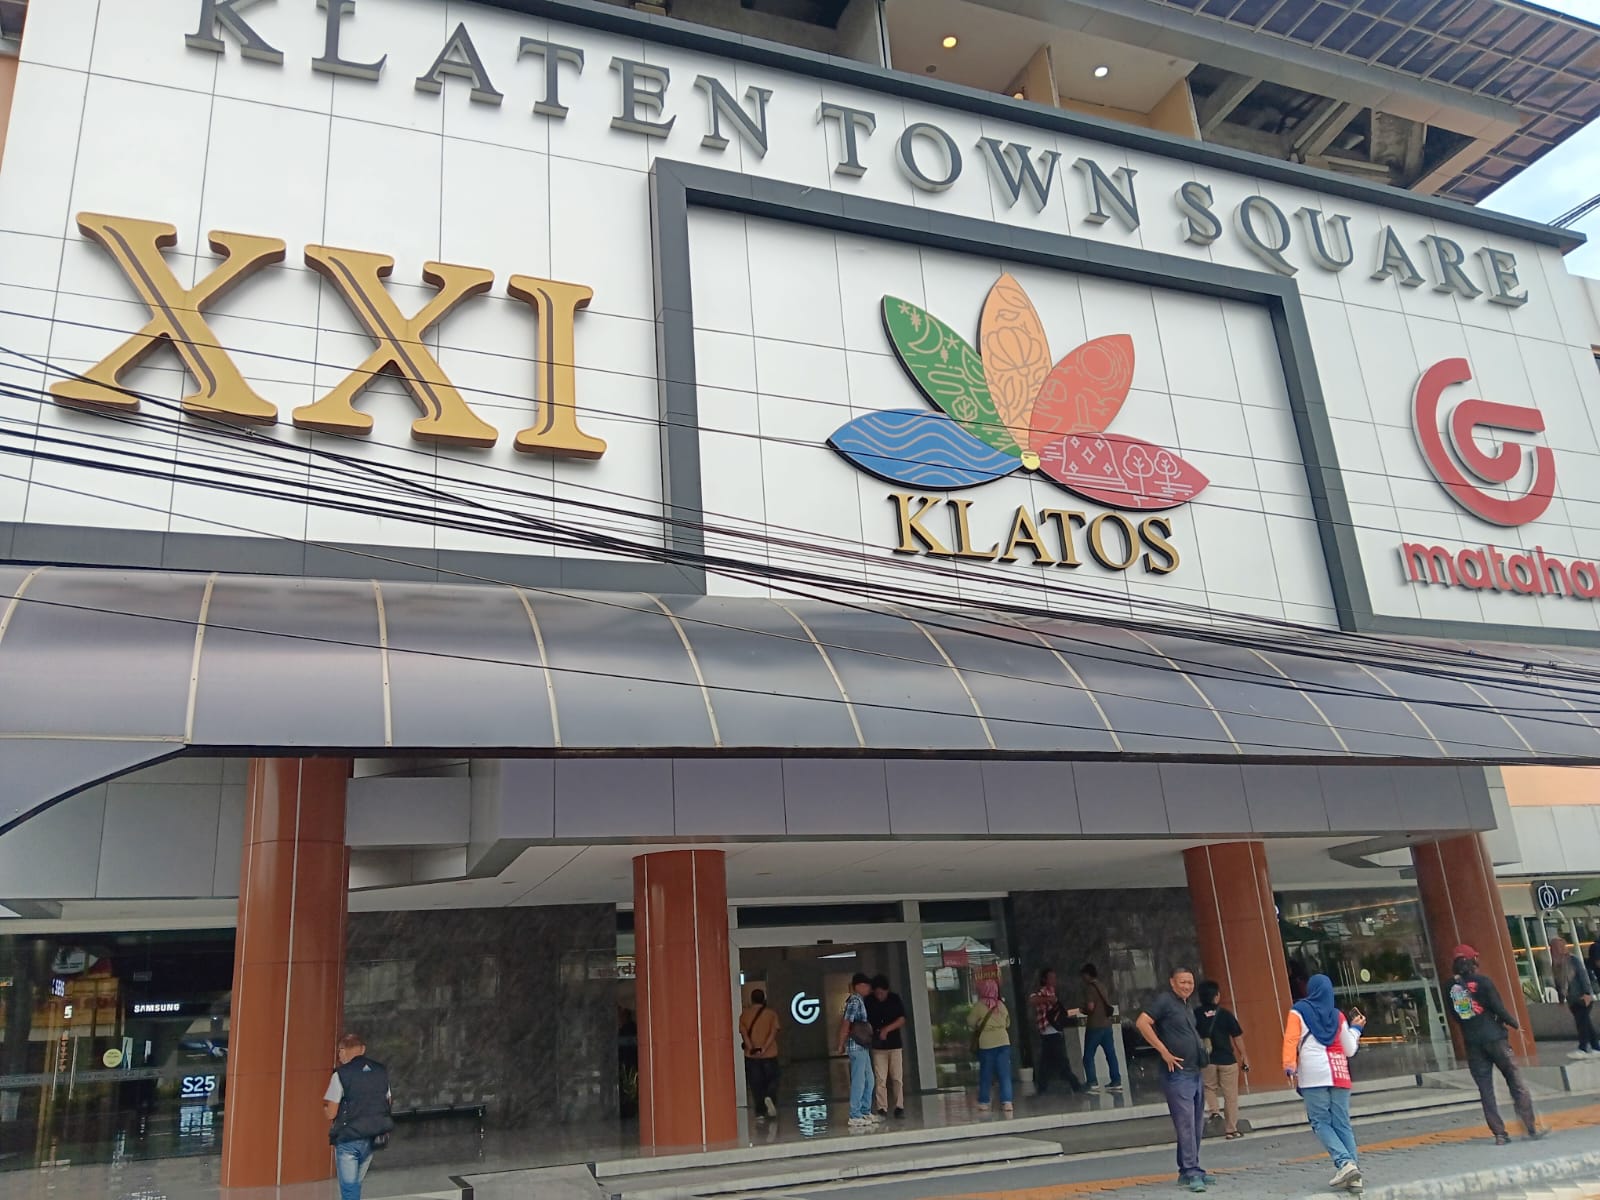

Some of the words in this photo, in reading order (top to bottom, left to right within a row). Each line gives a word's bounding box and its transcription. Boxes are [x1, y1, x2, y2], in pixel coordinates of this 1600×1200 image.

[185, 0, 773, 159] KLATEN
[816, 102, 1143, 232] TOWN
[1174, 180, 1530, 308] SQUARE
[48, 210, 608, 460] XXI
[887, 492, 1182, 575] KLATOS
[133, 1003, 180, 1013] SAMSUNG
[181, 1075, 216, 1093] S25
